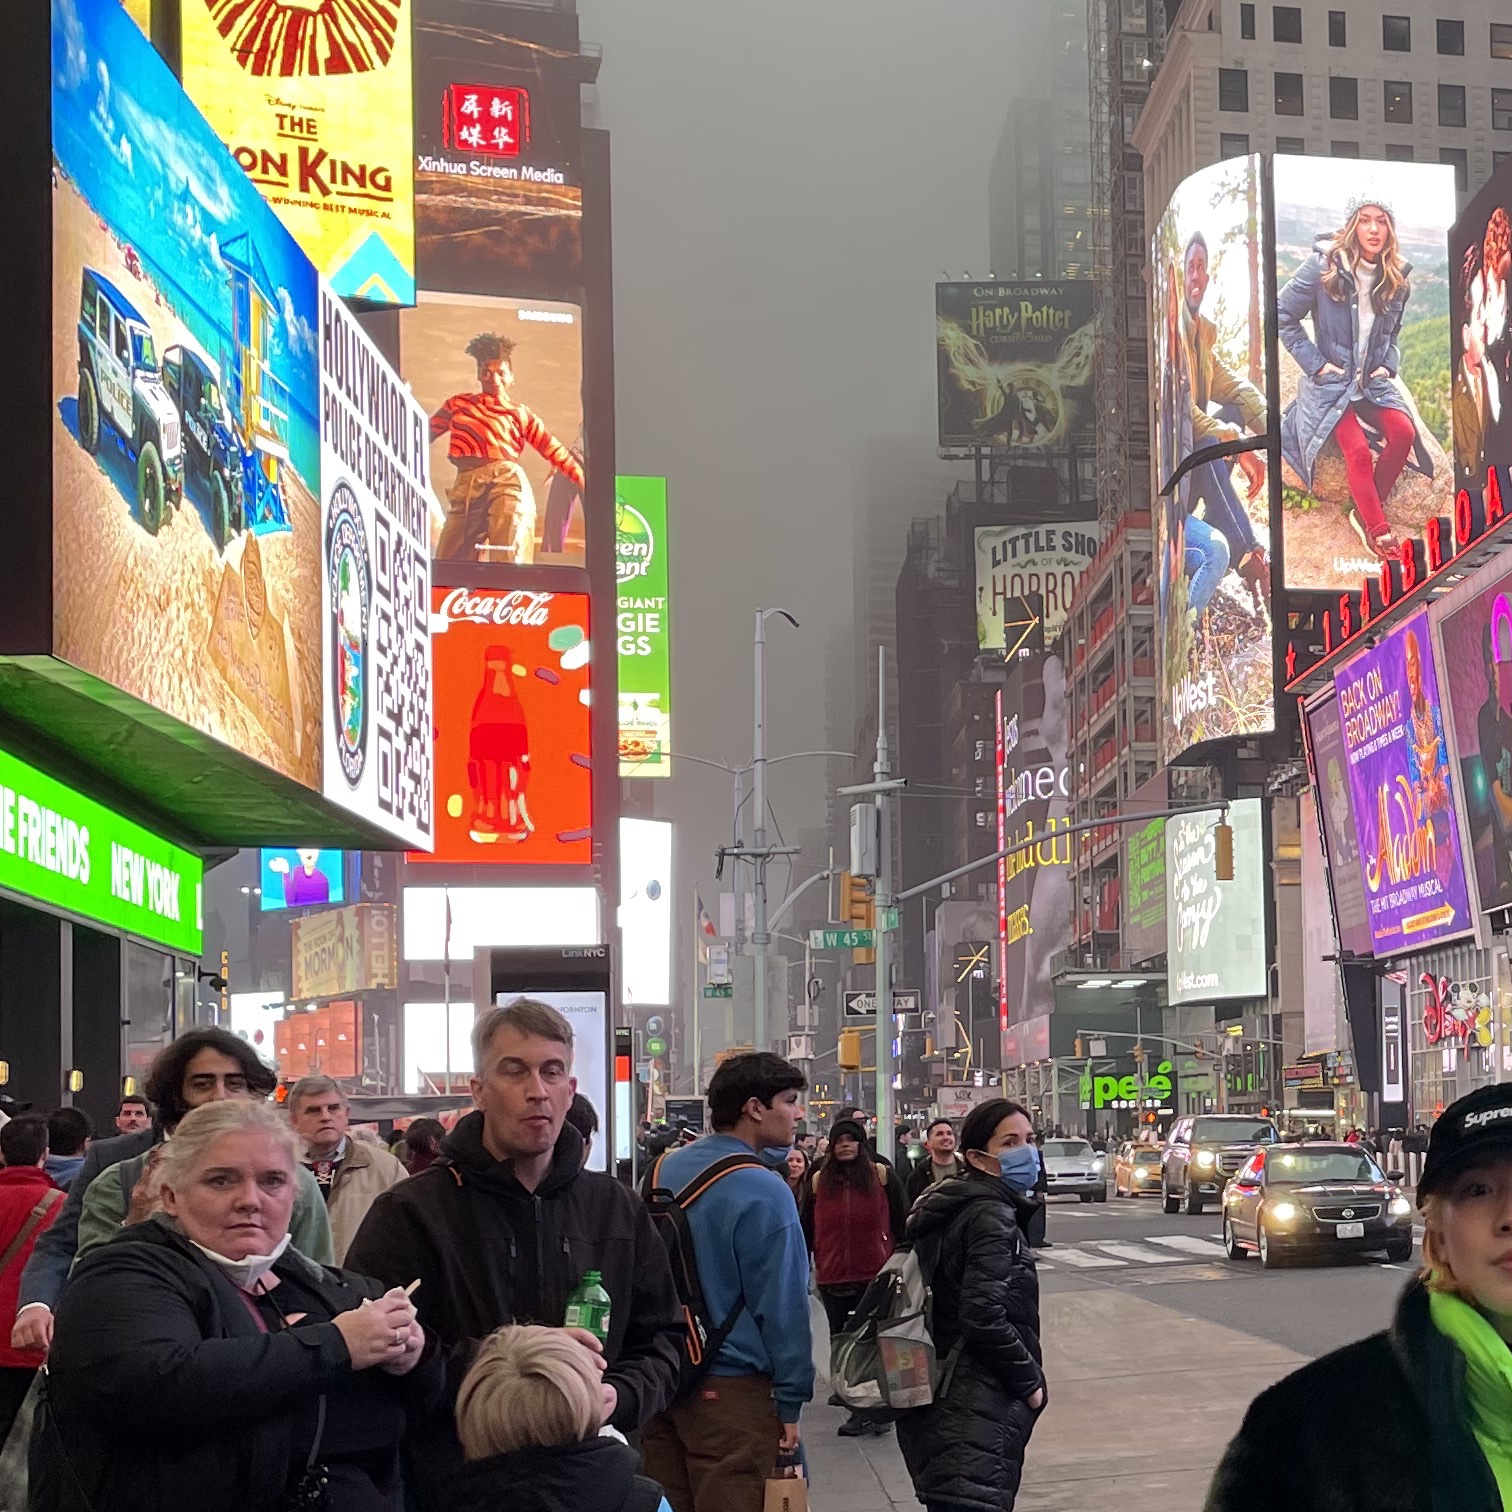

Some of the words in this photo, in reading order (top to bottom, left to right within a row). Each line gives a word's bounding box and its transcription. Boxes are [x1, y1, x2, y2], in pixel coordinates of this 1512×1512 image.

[275, 113, 318, 135] THE
[232, 145, 289, 178] ON
[298, 145, 392, 198] KING
[418, 155, 467, 175] Xinhua
[469, 160, 518, 181] Screen
[521, 165, 564, 184] Media
[973, 287, 994, 297] ON
[998, 286, 1065, 297] BROADWAY
[969, 304, 1019, 337] Harry
[1019, 300, 1072, 338] Potter
[101, 370, 133, 417] POLICE
[323, 382, 363, 482] POLICE
[364, 430, 428, 551] DEPARTMENT
[991, 530, 1056, 569] LITTLE
[1062, 530, 1099, 558] SHO
[1041, 558, 1054, 566] OF
[617, 596, 665, 609] GIANT
[992, 571, 1083, 618] HORRO
[1323, 559, 1392, 656] 1540
[1341, 676, 1367, 718] BACK
[1366, 663, 1383, 701] ON
[1345, 689, 1402, 749] BROADWAY!
[18, 794, 90, 886] FRIENDS
[111, 841, 145, 908] NEW
[145, 857, 181, 922] YORK
[1418, 877, 1443, 898] MUSICAL
[562, 949, 606, 958] LinkNYC
[826, 933, 838, 947] W
[843, 932, 859, 947] 45
[856, 1000, 877, 1009] ONE
[895, 998, 910, 1008] AY
[1111, 1099, 1161, 1108] SOCER
